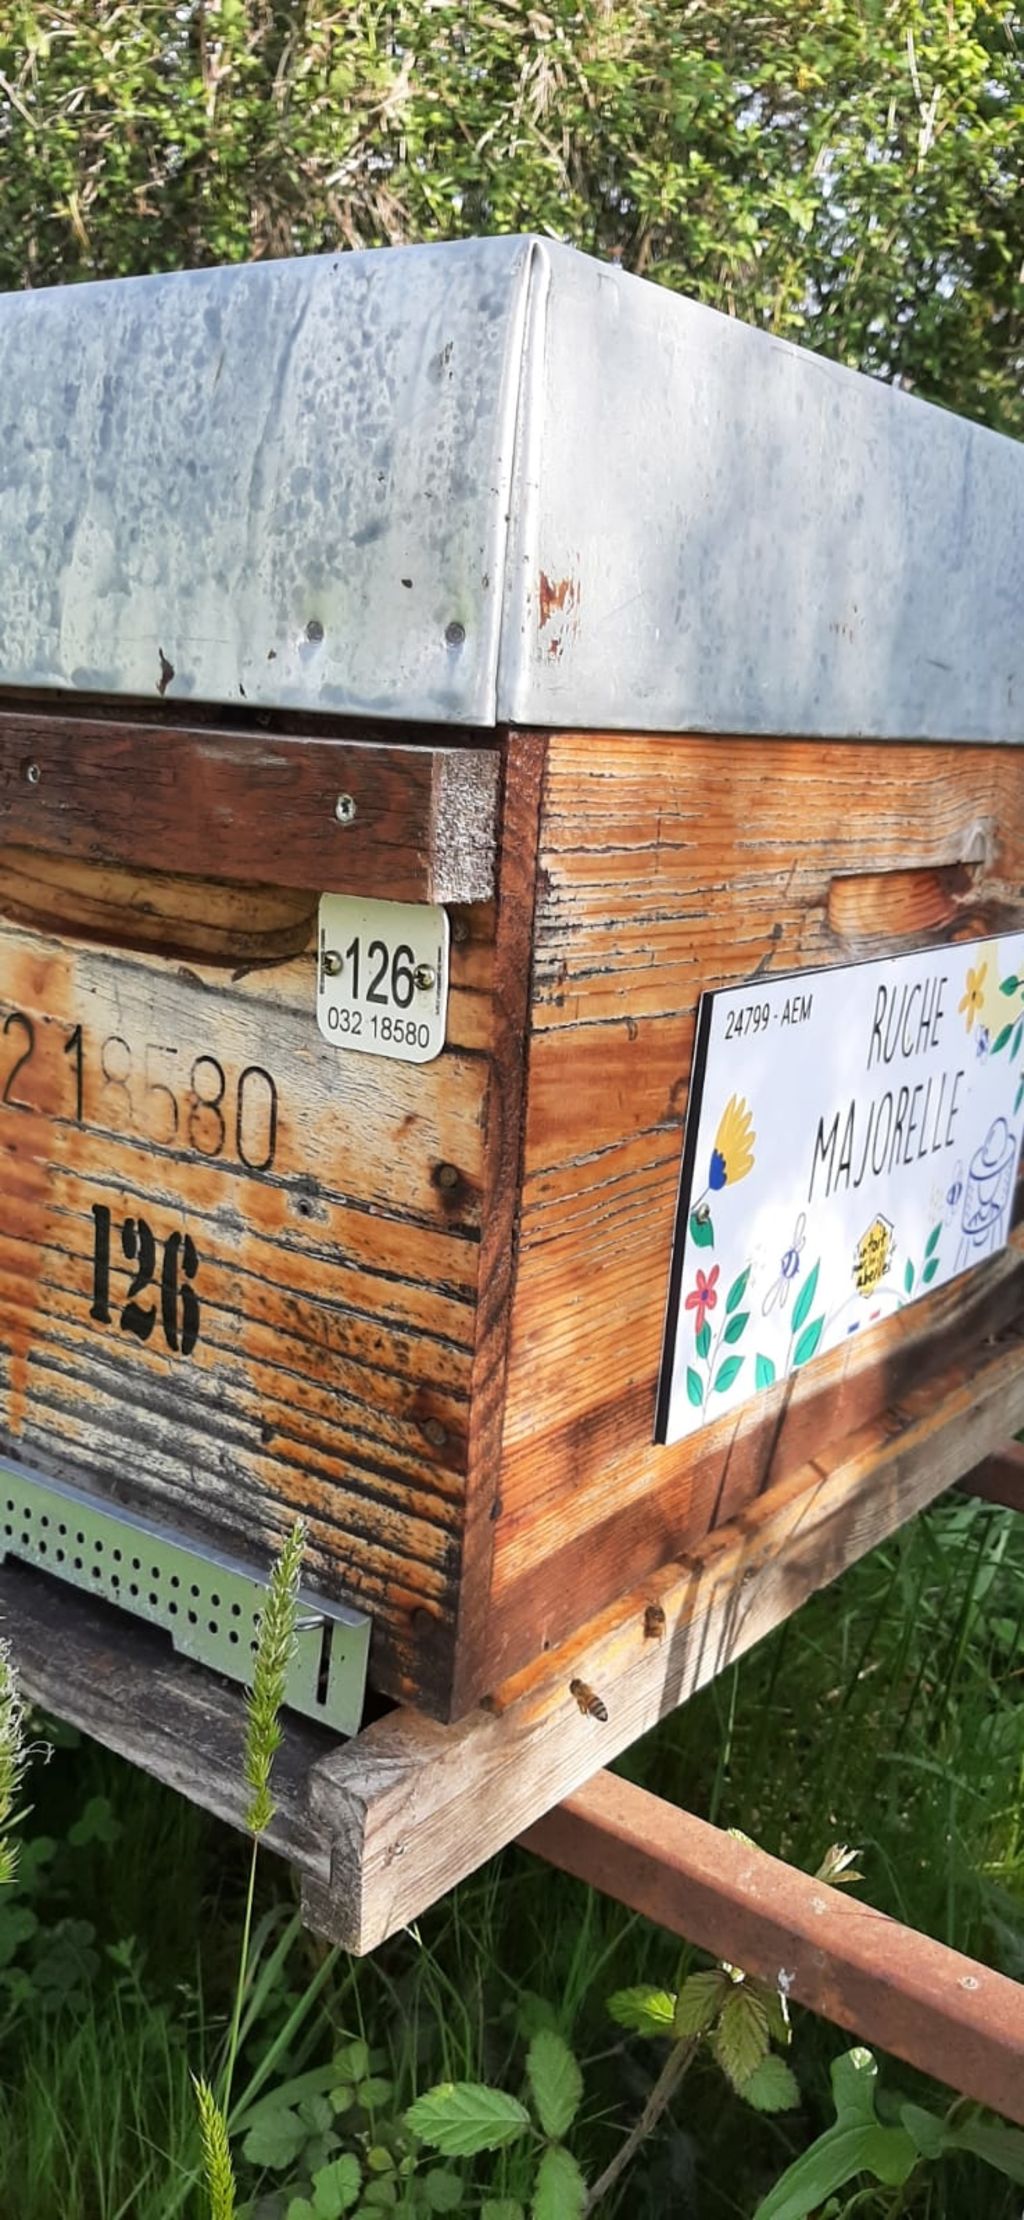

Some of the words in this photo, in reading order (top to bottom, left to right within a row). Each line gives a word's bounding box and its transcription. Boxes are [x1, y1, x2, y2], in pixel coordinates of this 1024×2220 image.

[346, 936, 415, 1009] 126
[327, 1006, 363, 1036] 032
[371, 1013, 430, 1049] 18580
[724, 1003, 770, 1040] 24799
[780, 993, 813, 1027] AEM
[867, 976, 948, 1070] RUCHE
[808, 1070, 965, 1204] MAJORELLE
[89, 1203, 200, 1356] 126
